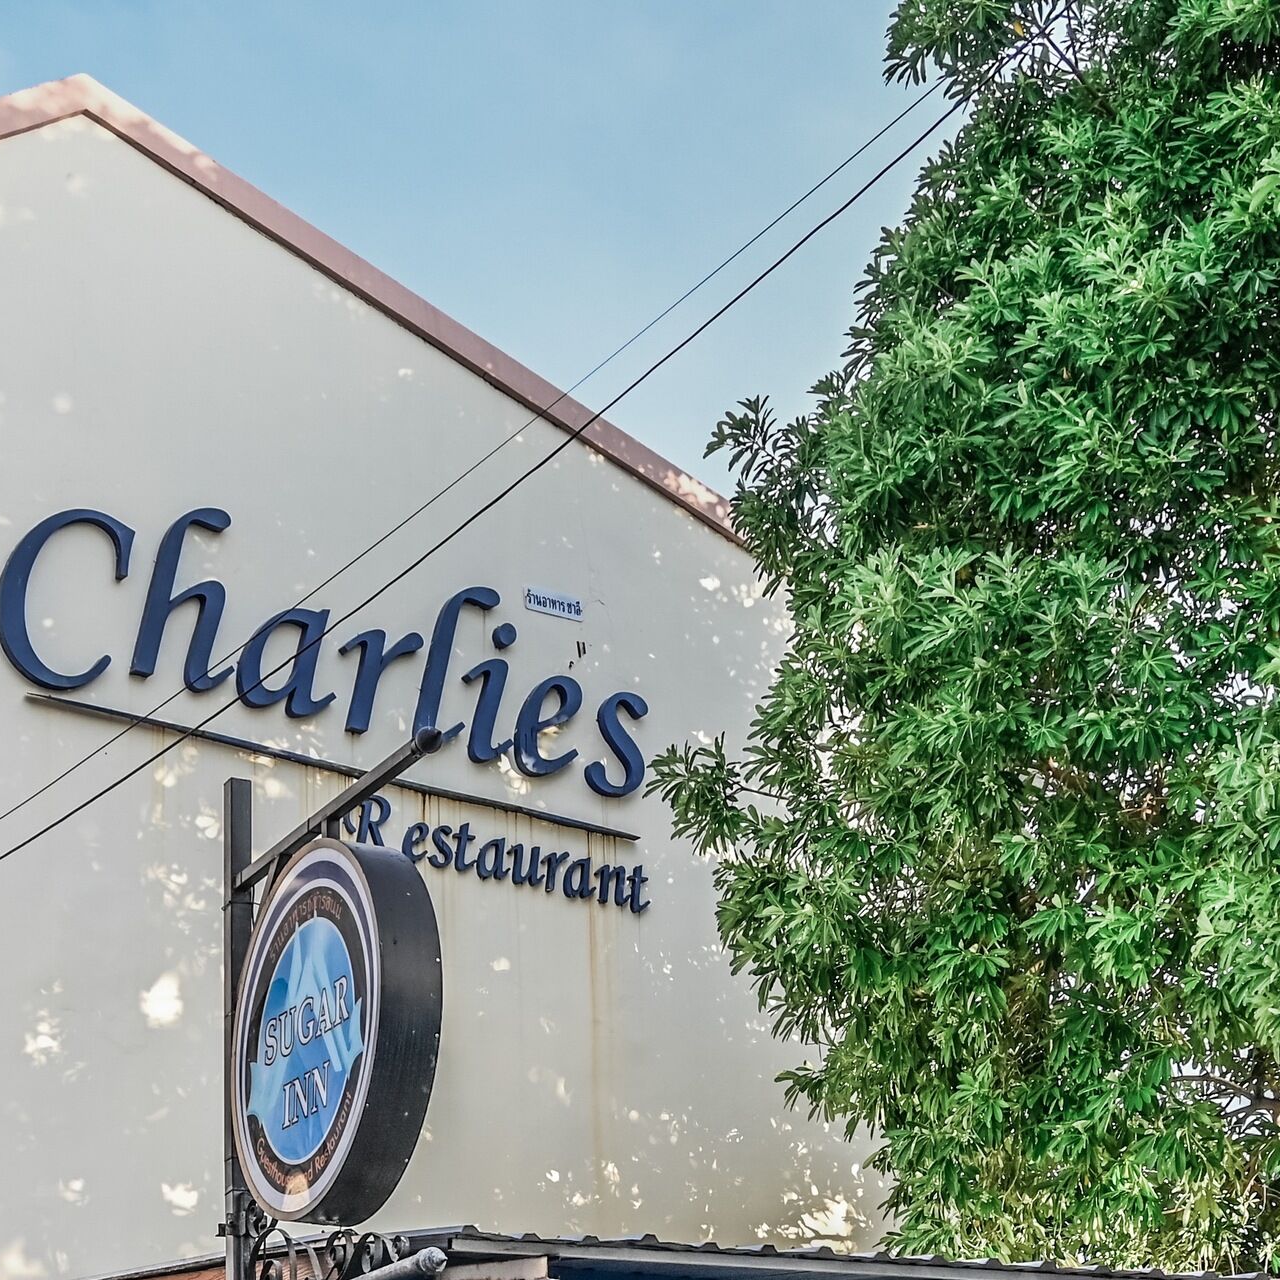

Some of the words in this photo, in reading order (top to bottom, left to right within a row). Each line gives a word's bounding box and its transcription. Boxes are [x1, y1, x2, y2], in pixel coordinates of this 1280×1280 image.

[342, 794, 651, 914] Restaurant
[263, 974, 349, 1067] SUGAR
[281, 1061, 331, 1131] INN
[314, 1091, 353, 1173] Restaurant
